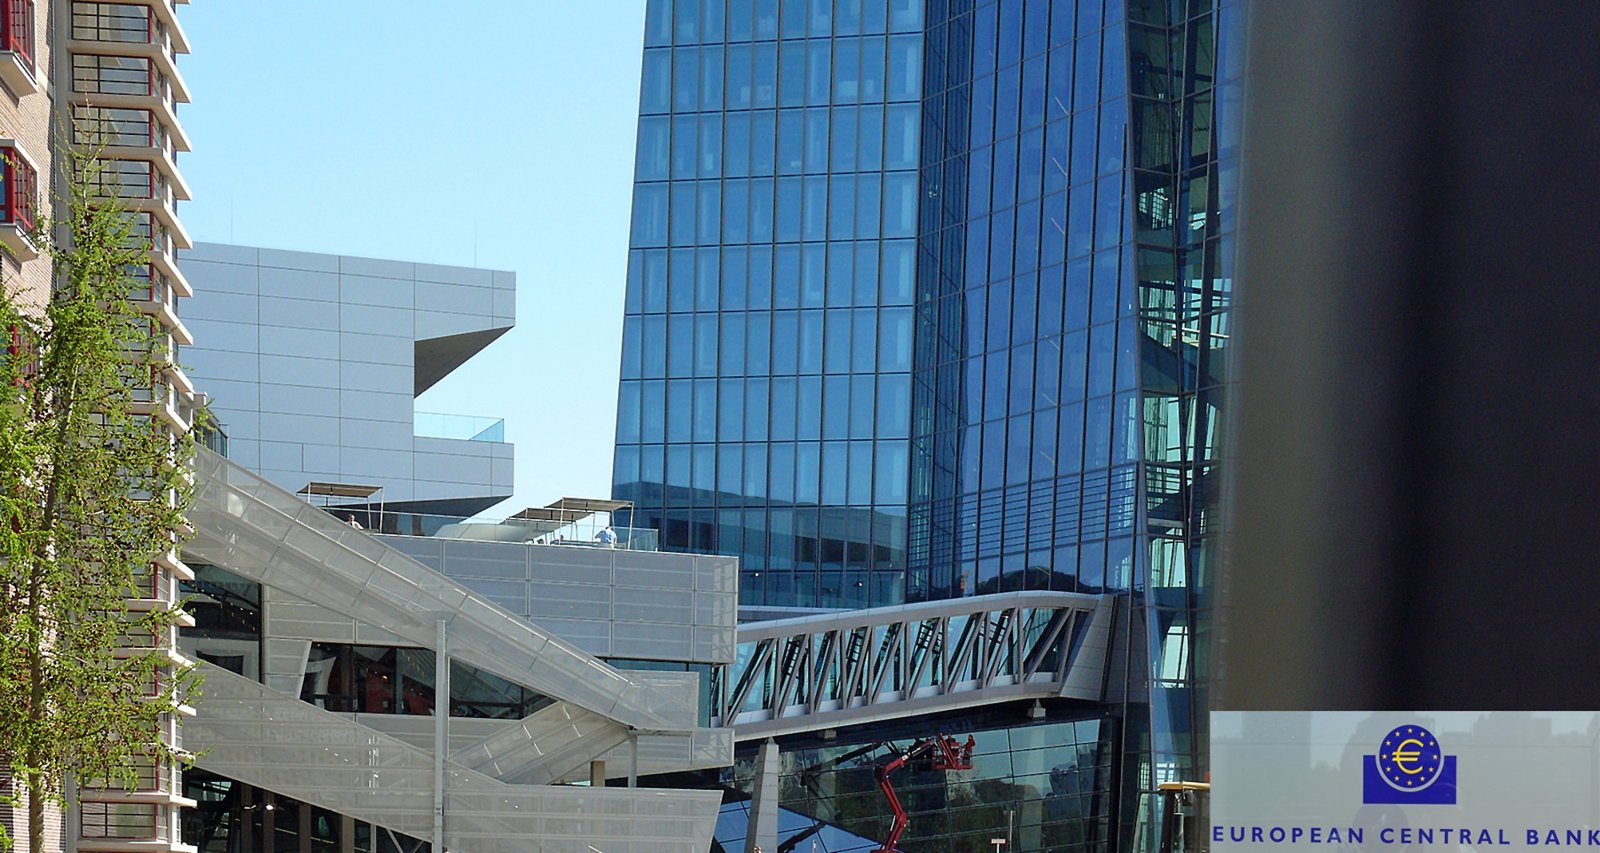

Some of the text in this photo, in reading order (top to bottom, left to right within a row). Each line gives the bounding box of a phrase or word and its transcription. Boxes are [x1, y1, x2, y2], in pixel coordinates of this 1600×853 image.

[1213, 826, 1600, 846] EUROPEAN CENTRAL BANK
